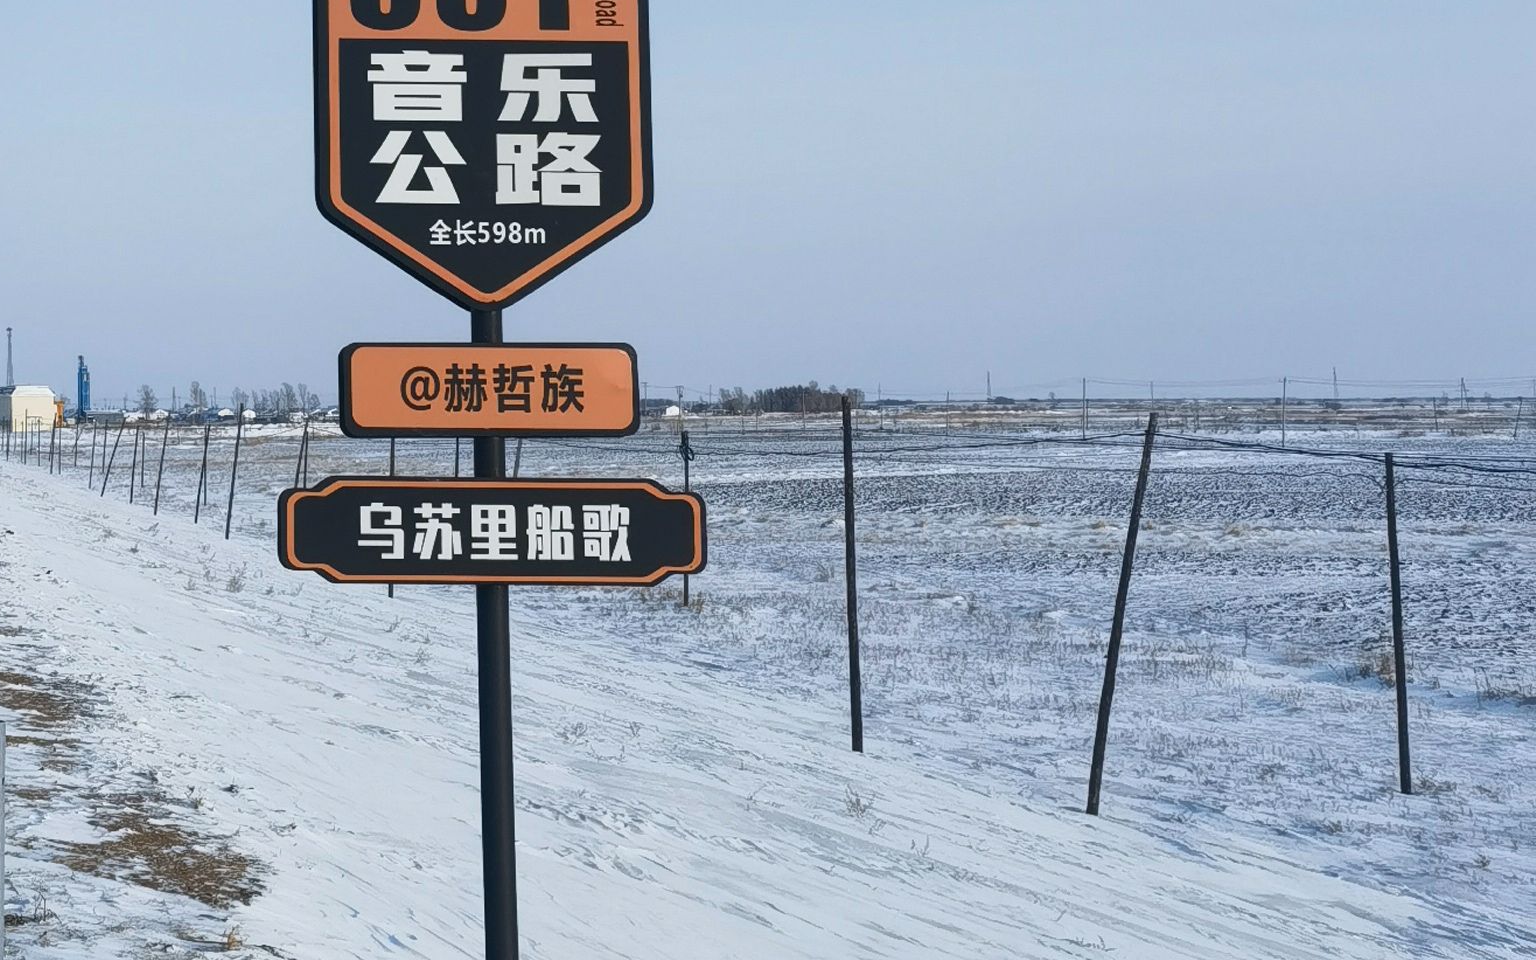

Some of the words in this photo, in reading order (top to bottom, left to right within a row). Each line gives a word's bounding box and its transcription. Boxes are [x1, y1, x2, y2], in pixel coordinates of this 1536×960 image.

[367, 49, 600, 123] 音乐
[369, 131, 603, 207] 公路
[429, 219, 546, 246] 全长598m
[400, 363, 584, 414] @赫哲族
[357, 502, 631, 561] 乌苏里船歌
